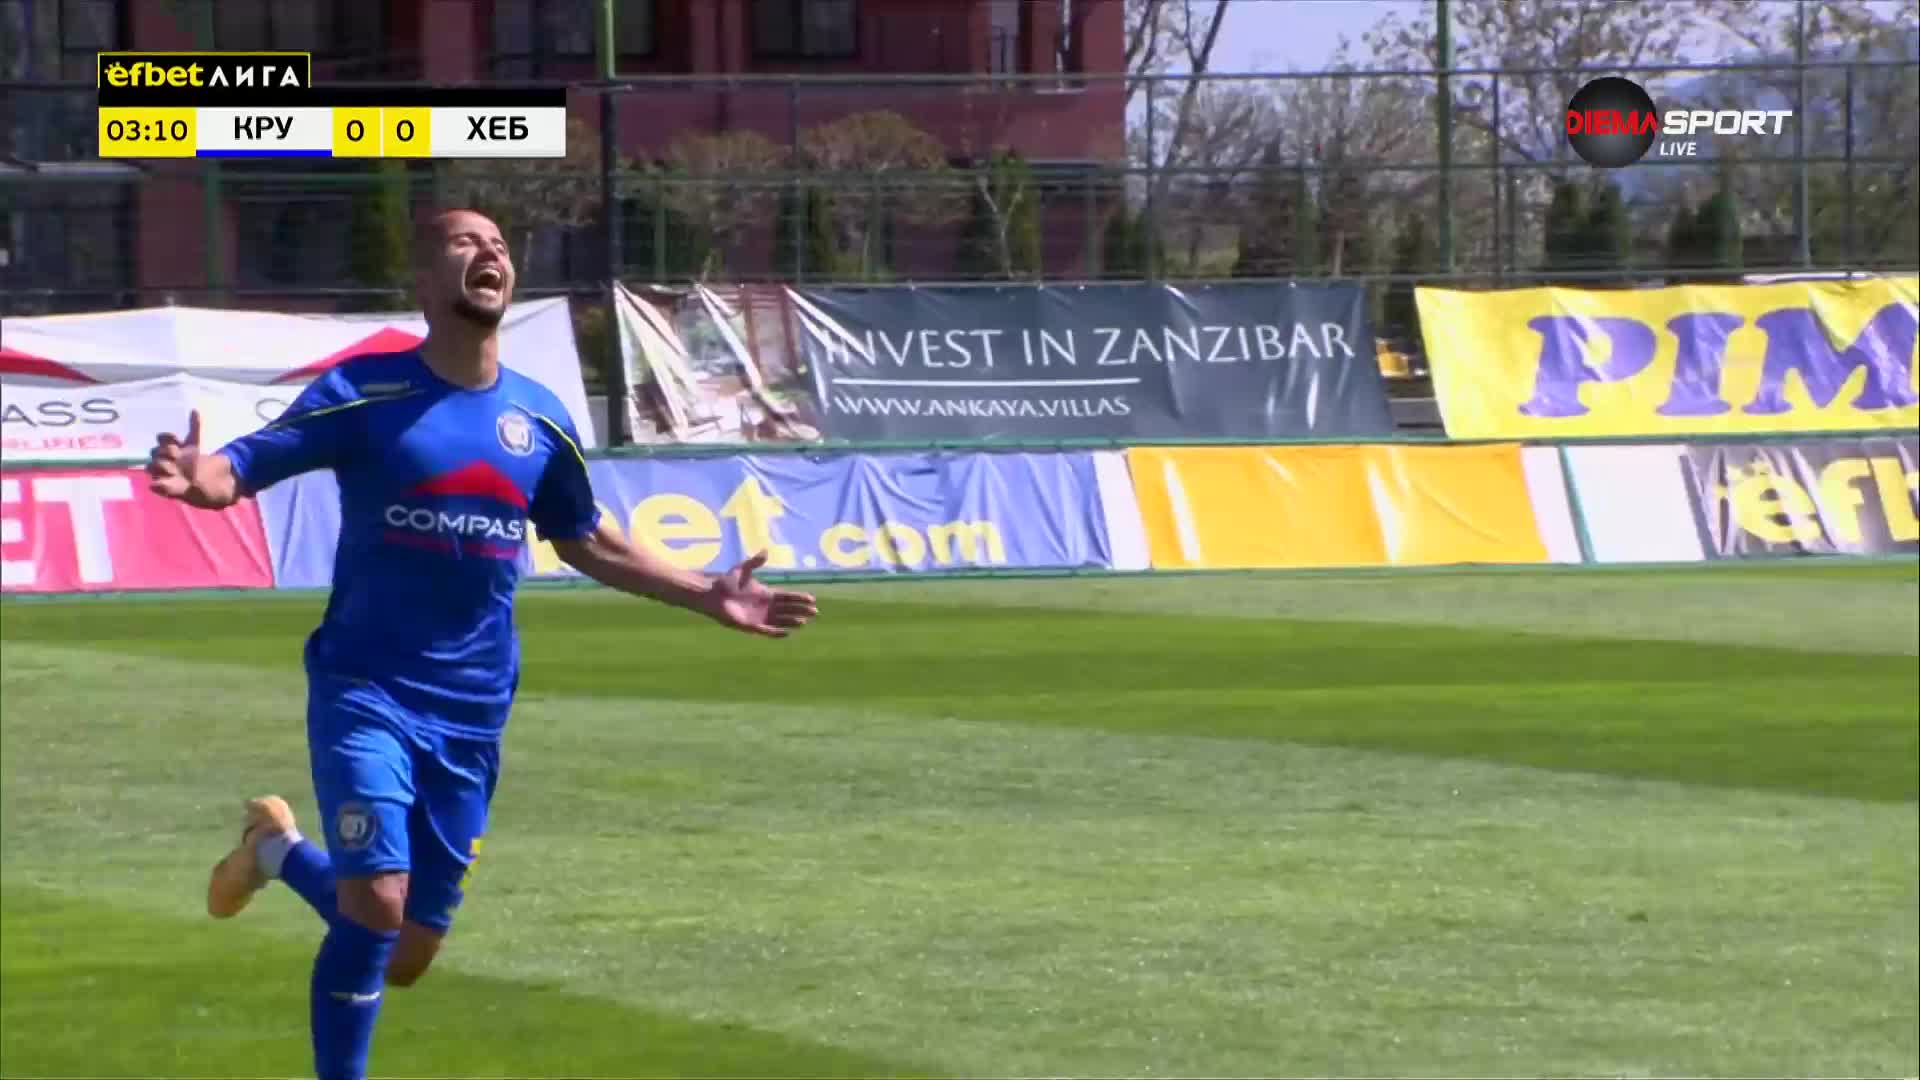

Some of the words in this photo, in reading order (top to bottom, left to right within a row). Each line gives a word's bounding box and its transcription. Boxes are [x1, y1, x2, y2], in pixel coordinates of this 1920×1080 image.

[824, 328, 1003, 369] INVEST
[1021, 328, 1078, 367] IN
[1092, 321, 1356, 366] ZANZIBAR
[833, 394, 1131, 418] WWW.ANKAYA.VILLAS
[385, 504, 526, 542] COMPAS
